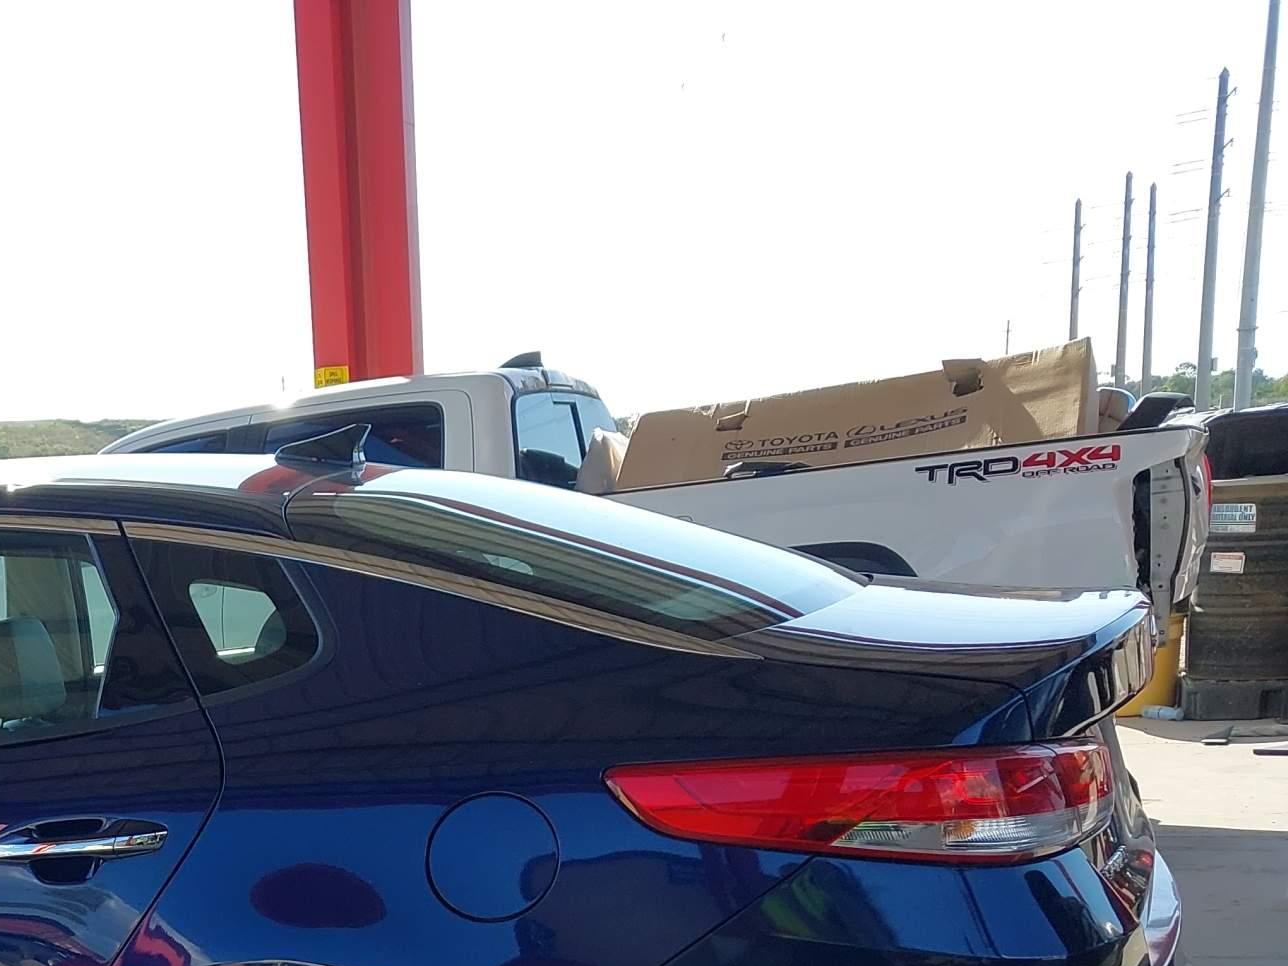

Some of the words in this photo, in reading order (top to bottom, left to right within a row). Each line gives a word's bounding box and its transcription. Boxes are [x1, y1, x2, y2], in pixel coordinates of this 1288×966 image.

[880, 407, 968, 431] LEXUS
[758, 431, 839, 448] TOYOTA
[915, 455, 1021, 487] TRD
[1022, 444, 1121, 469] 4X4
[1022, 468, 1058, 478] OFF
[1063, 462, 1117, 475] ROAD
